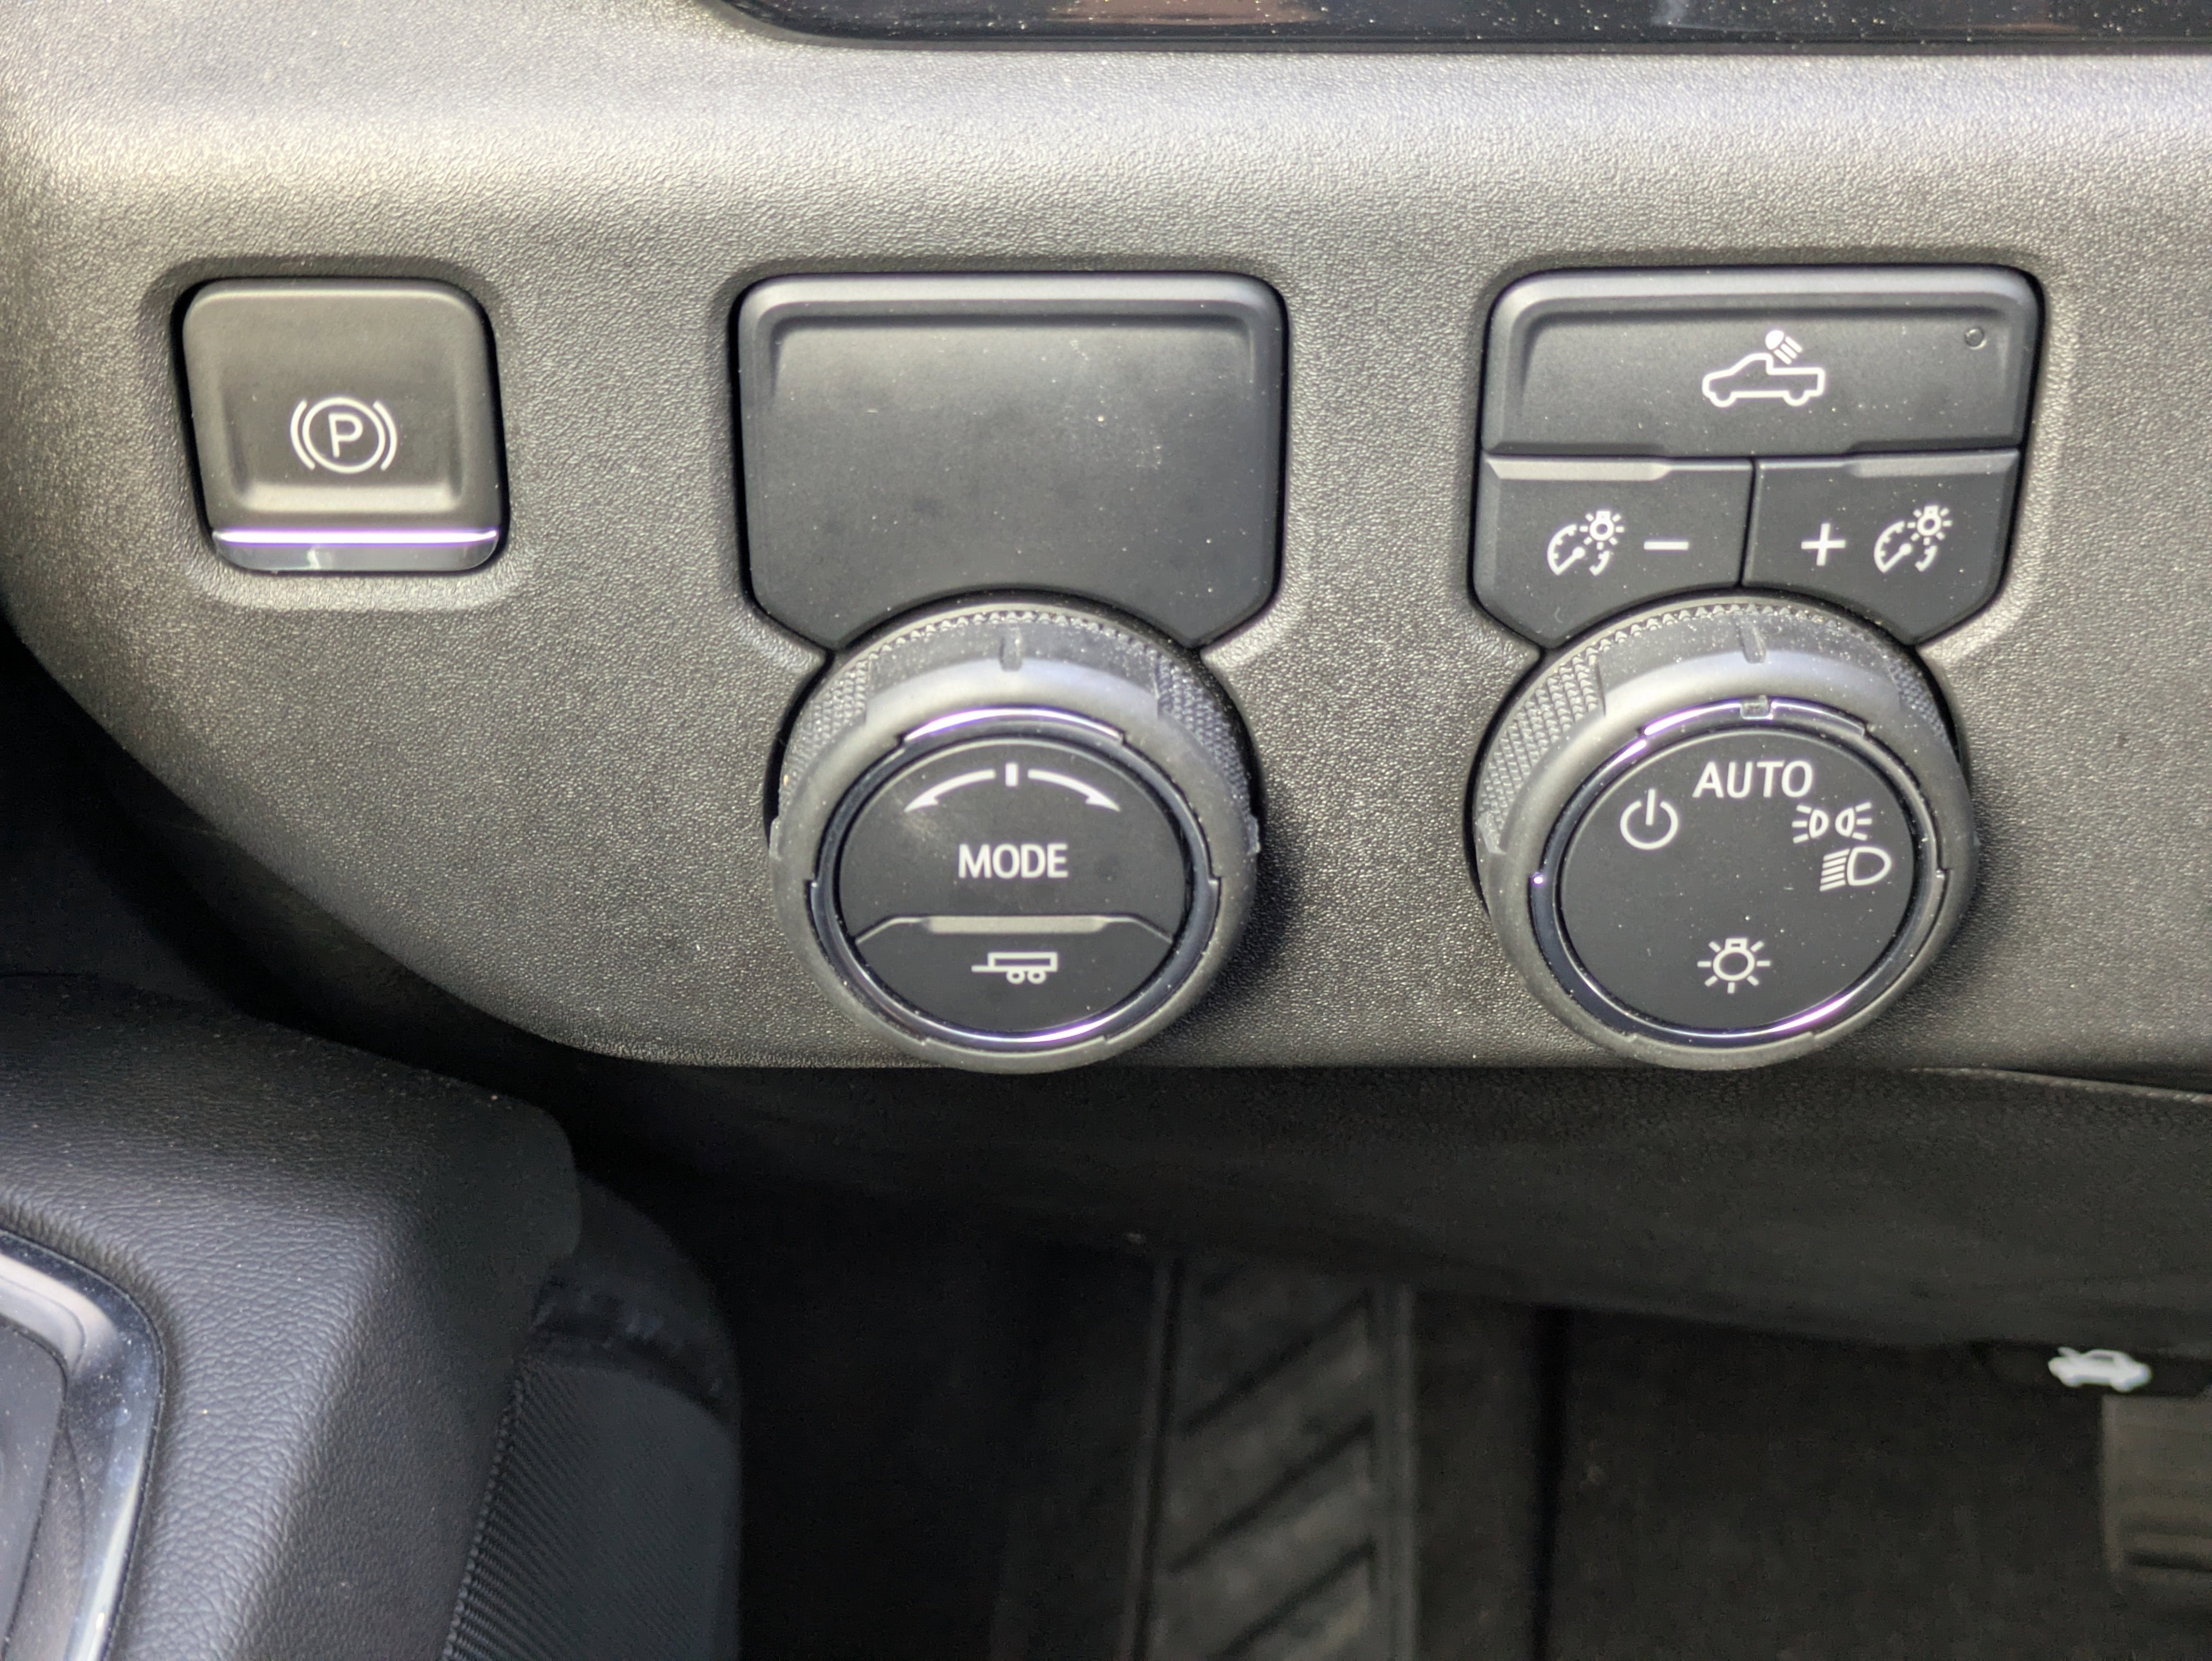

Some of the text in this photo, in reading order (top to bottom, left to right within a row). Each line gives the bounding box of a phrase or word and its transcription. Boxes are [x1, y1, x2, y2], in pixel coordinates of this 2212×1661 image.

[328, 411, 364, 458] P
[1692, 760, 1814, 799] AUTO
[958, 842, 1069, 879] MODE
